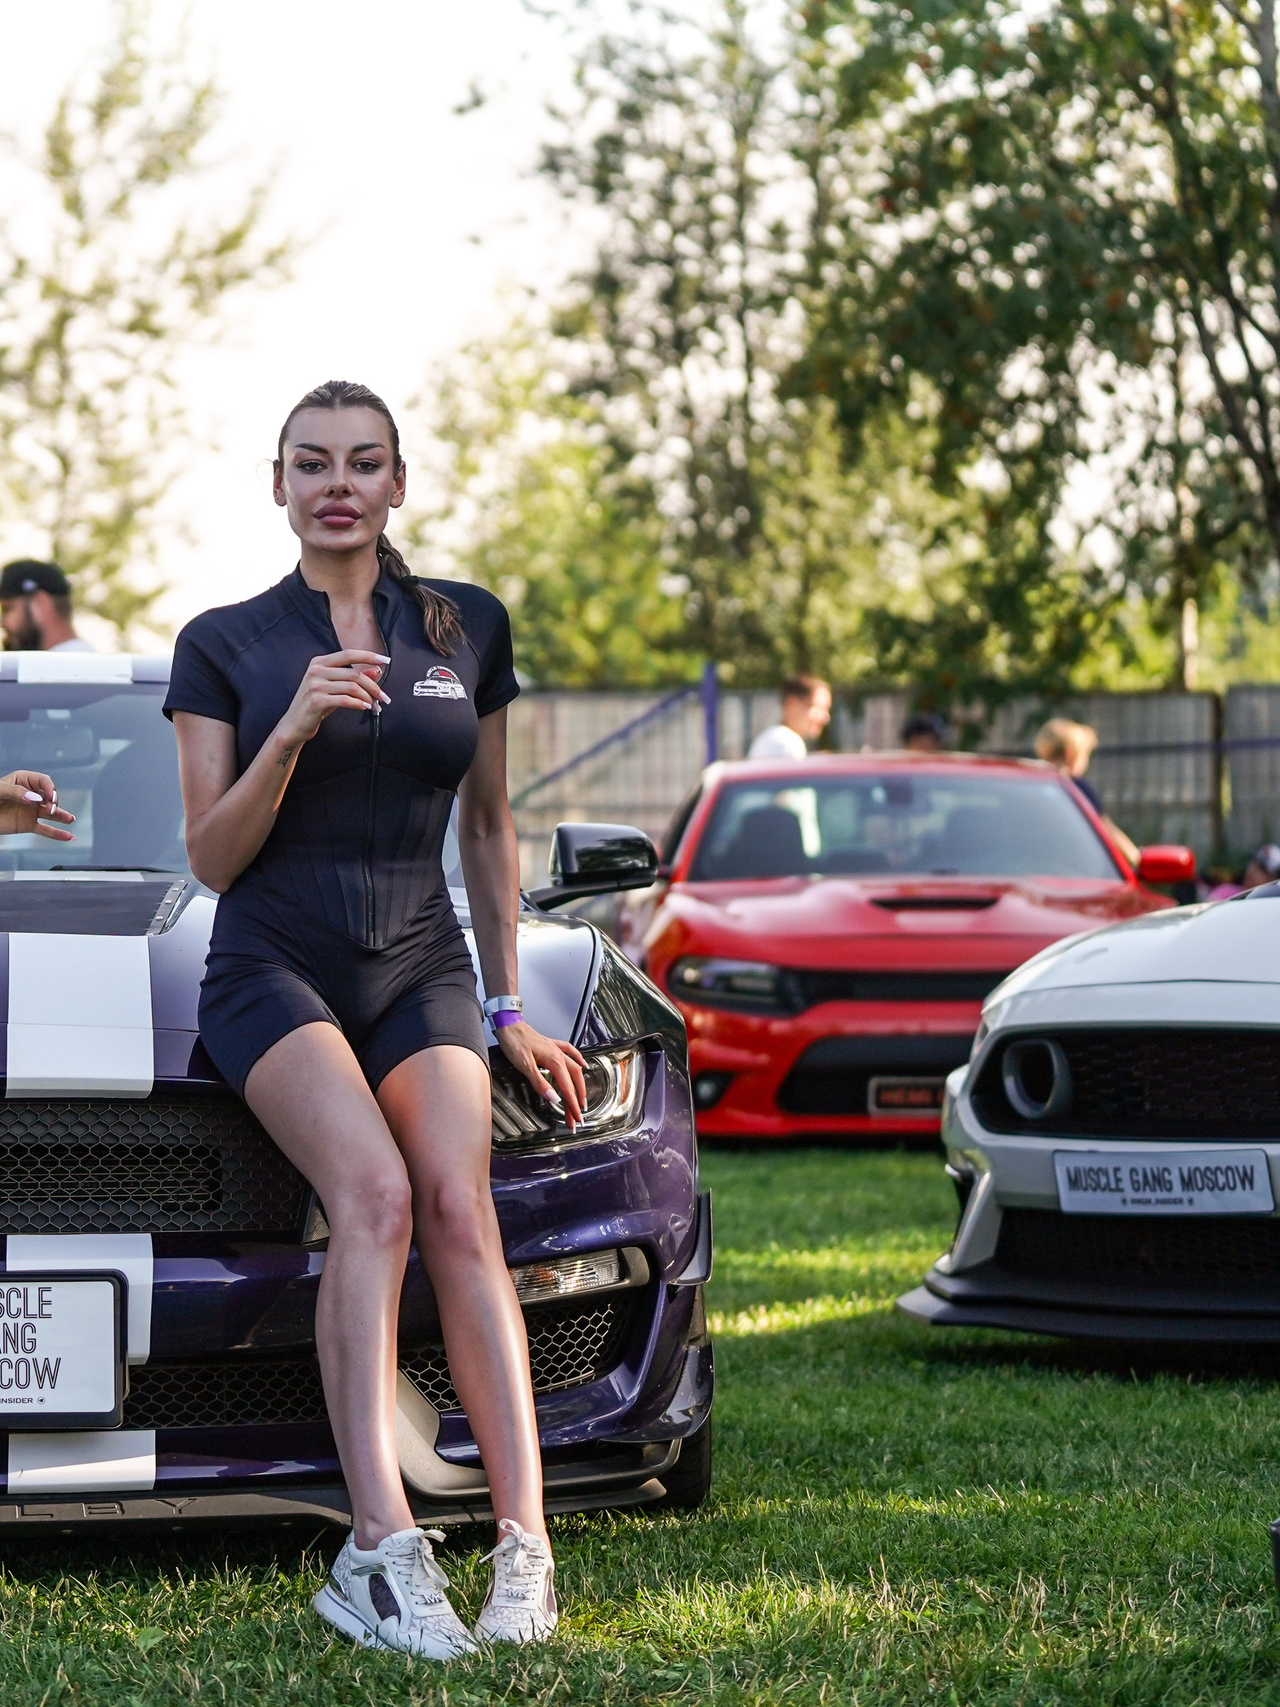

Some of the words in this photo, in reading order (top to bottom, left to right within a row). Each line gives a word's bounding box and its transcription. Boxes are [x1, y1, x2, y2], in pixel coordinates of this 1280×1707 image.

[1066, 1165, 1125, 1193] MUSCLE
[1129, 1165, 1173, 1193] GANG
[1178, 1164, 1255, 1192] MOSCOW
[423, 1591, 444, 1605] MK
